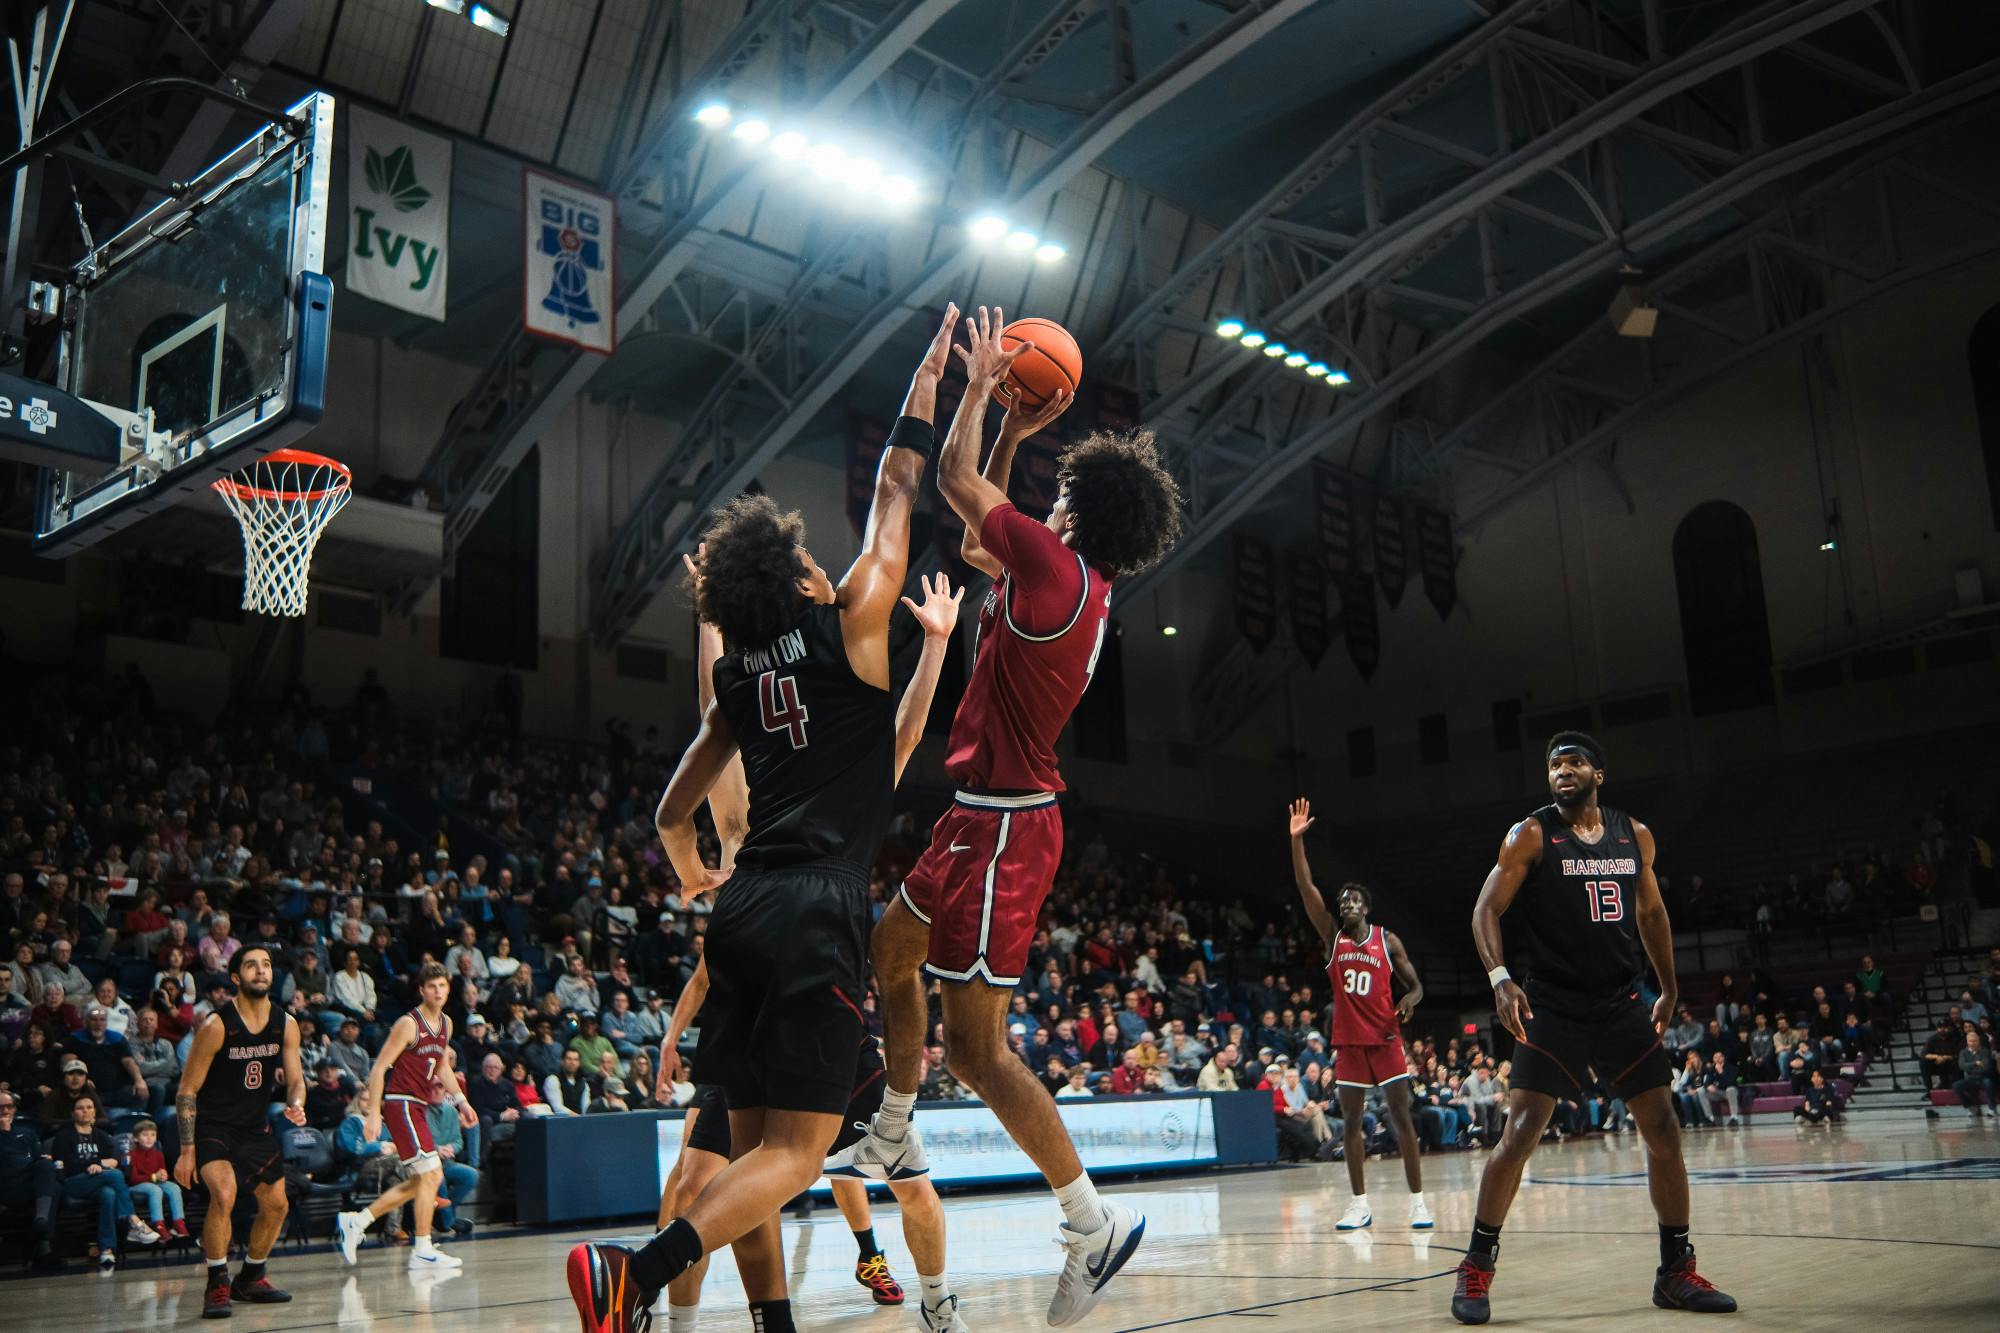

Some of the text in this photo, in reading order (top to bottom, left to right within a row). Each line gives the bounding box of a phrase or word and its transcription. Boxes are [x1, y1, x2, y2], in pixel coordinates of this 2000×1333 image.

[541, 199, 599, 234] BIG
[354, 206, 439, 291] Ivy
[743, 628, 807, 674] HINTON
[758, 670, 808, 750] 4
[1561, 858, 1636, 875] HARVARD
[1585, 881, 1623, 922] 13
[1343, 968, 1371, 996] 30
[244, 1060, 262, 1090] 8
